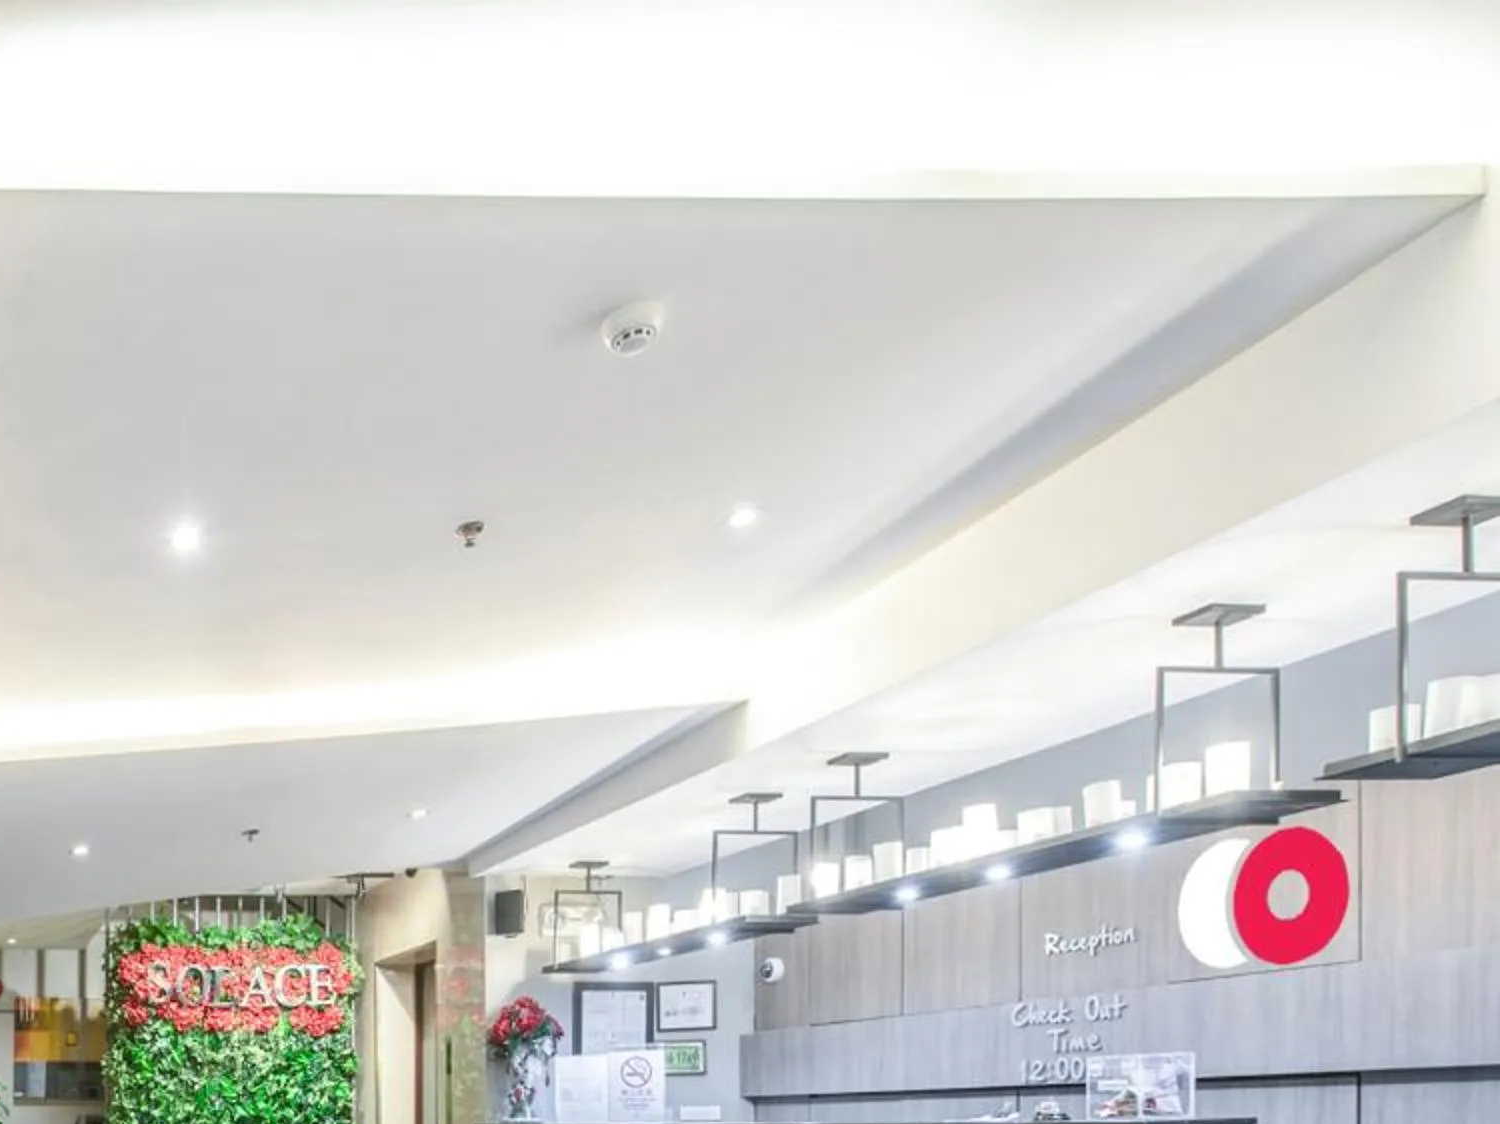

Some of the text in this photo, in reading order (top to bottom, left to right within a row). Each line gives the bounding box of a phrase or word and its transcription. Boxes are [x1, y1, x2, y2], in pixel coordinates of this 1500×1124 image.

[1044, 925, 1135, 957] Reception
[147, 960, 336, 1008] SOLACE
[1012, 994, 1128, 1027] Check Out
